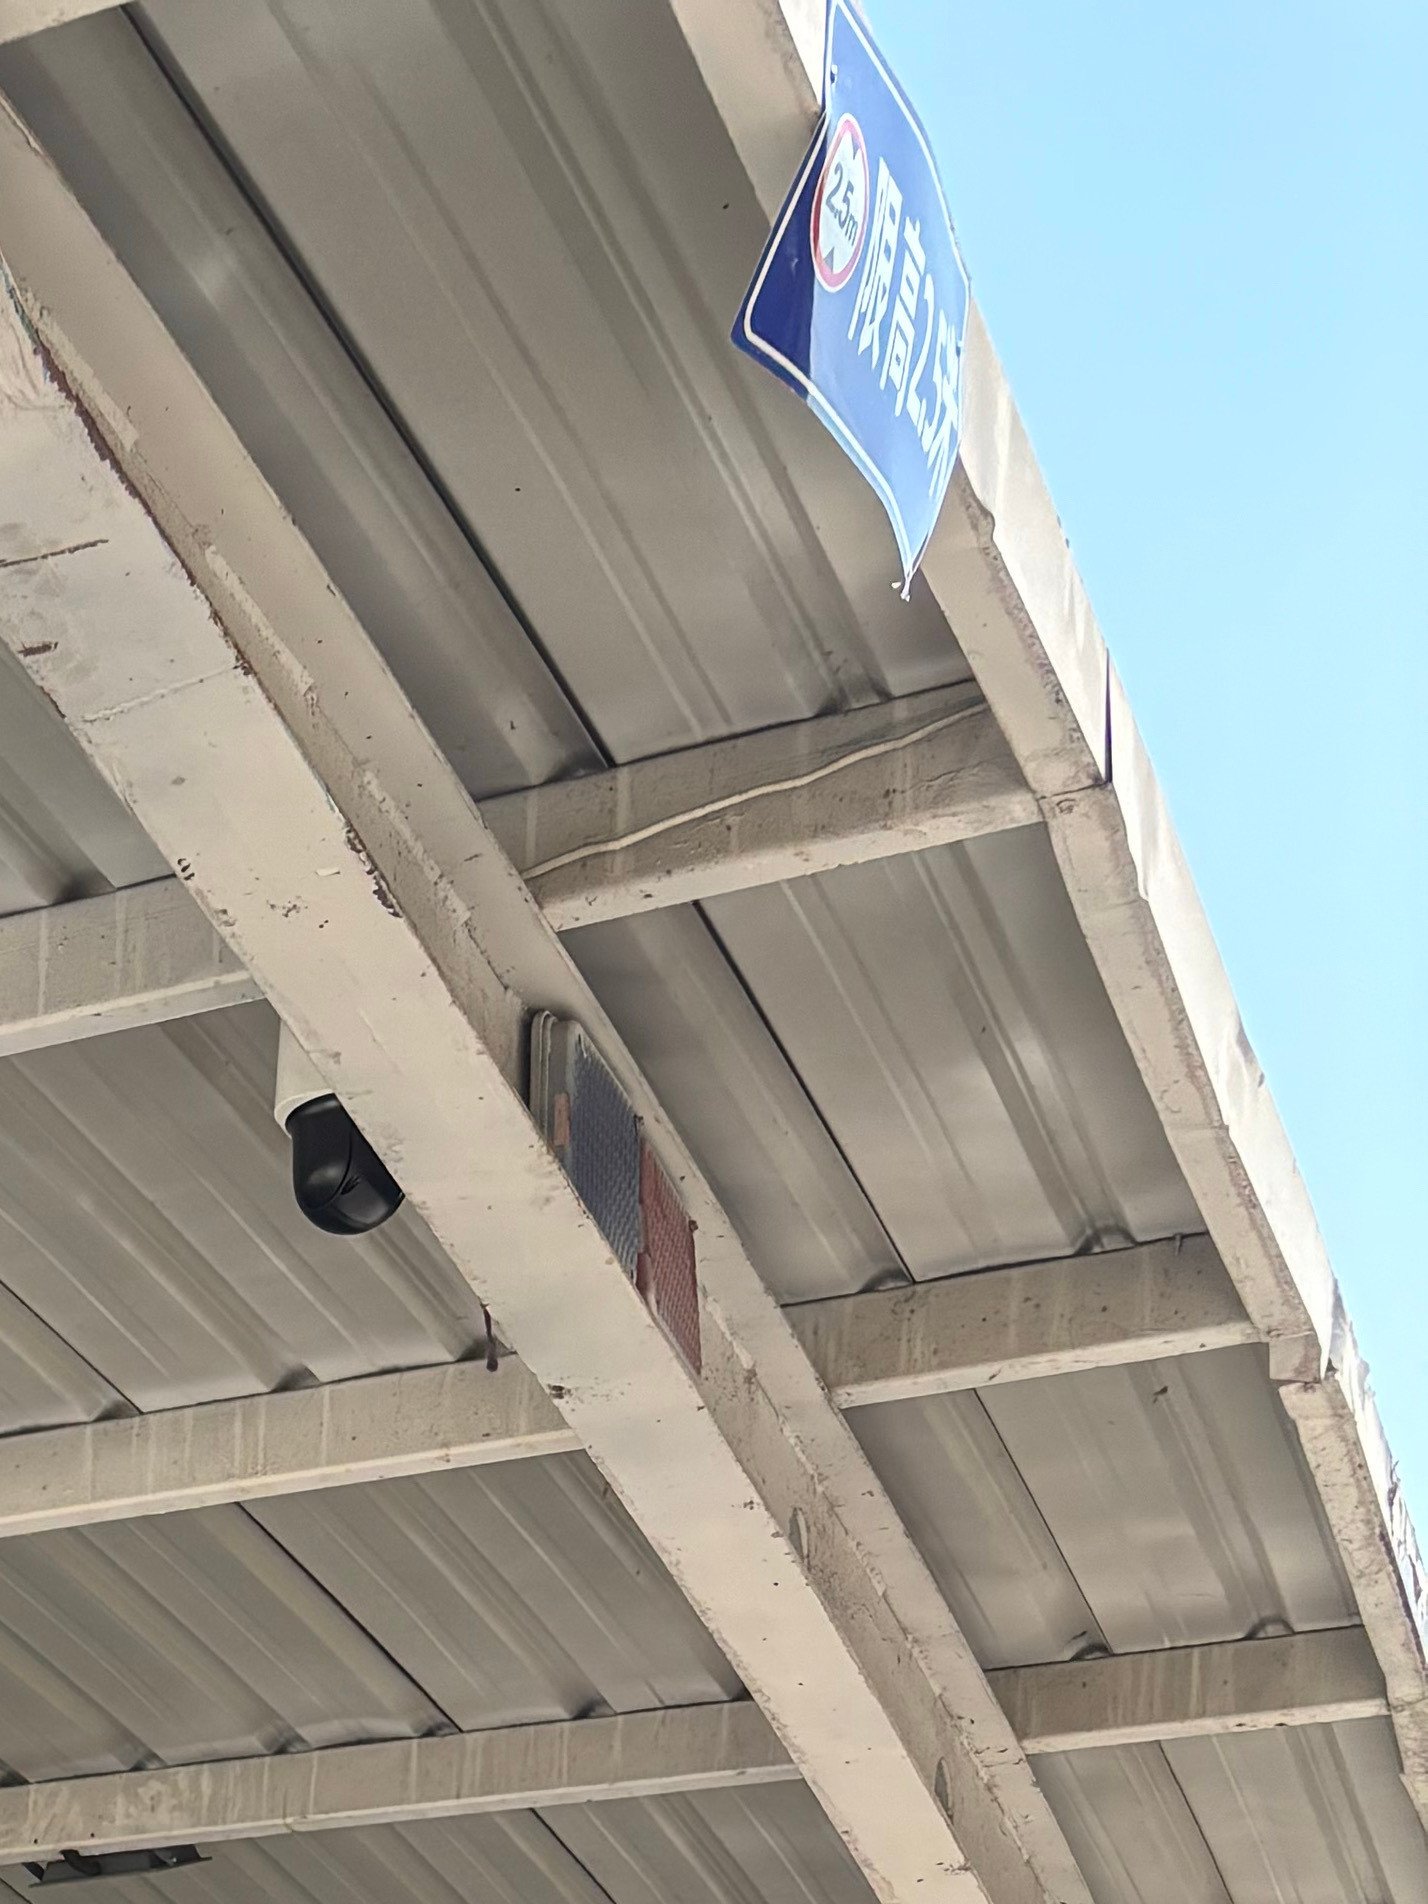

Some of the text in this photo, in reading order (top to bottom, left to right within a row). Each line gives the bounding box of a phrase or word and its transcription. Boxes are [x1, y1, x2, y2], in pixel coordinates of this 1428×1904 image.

[826, 161, 858, 246] 2.5m
[848, 158, 960, 499] 限高2.5米
